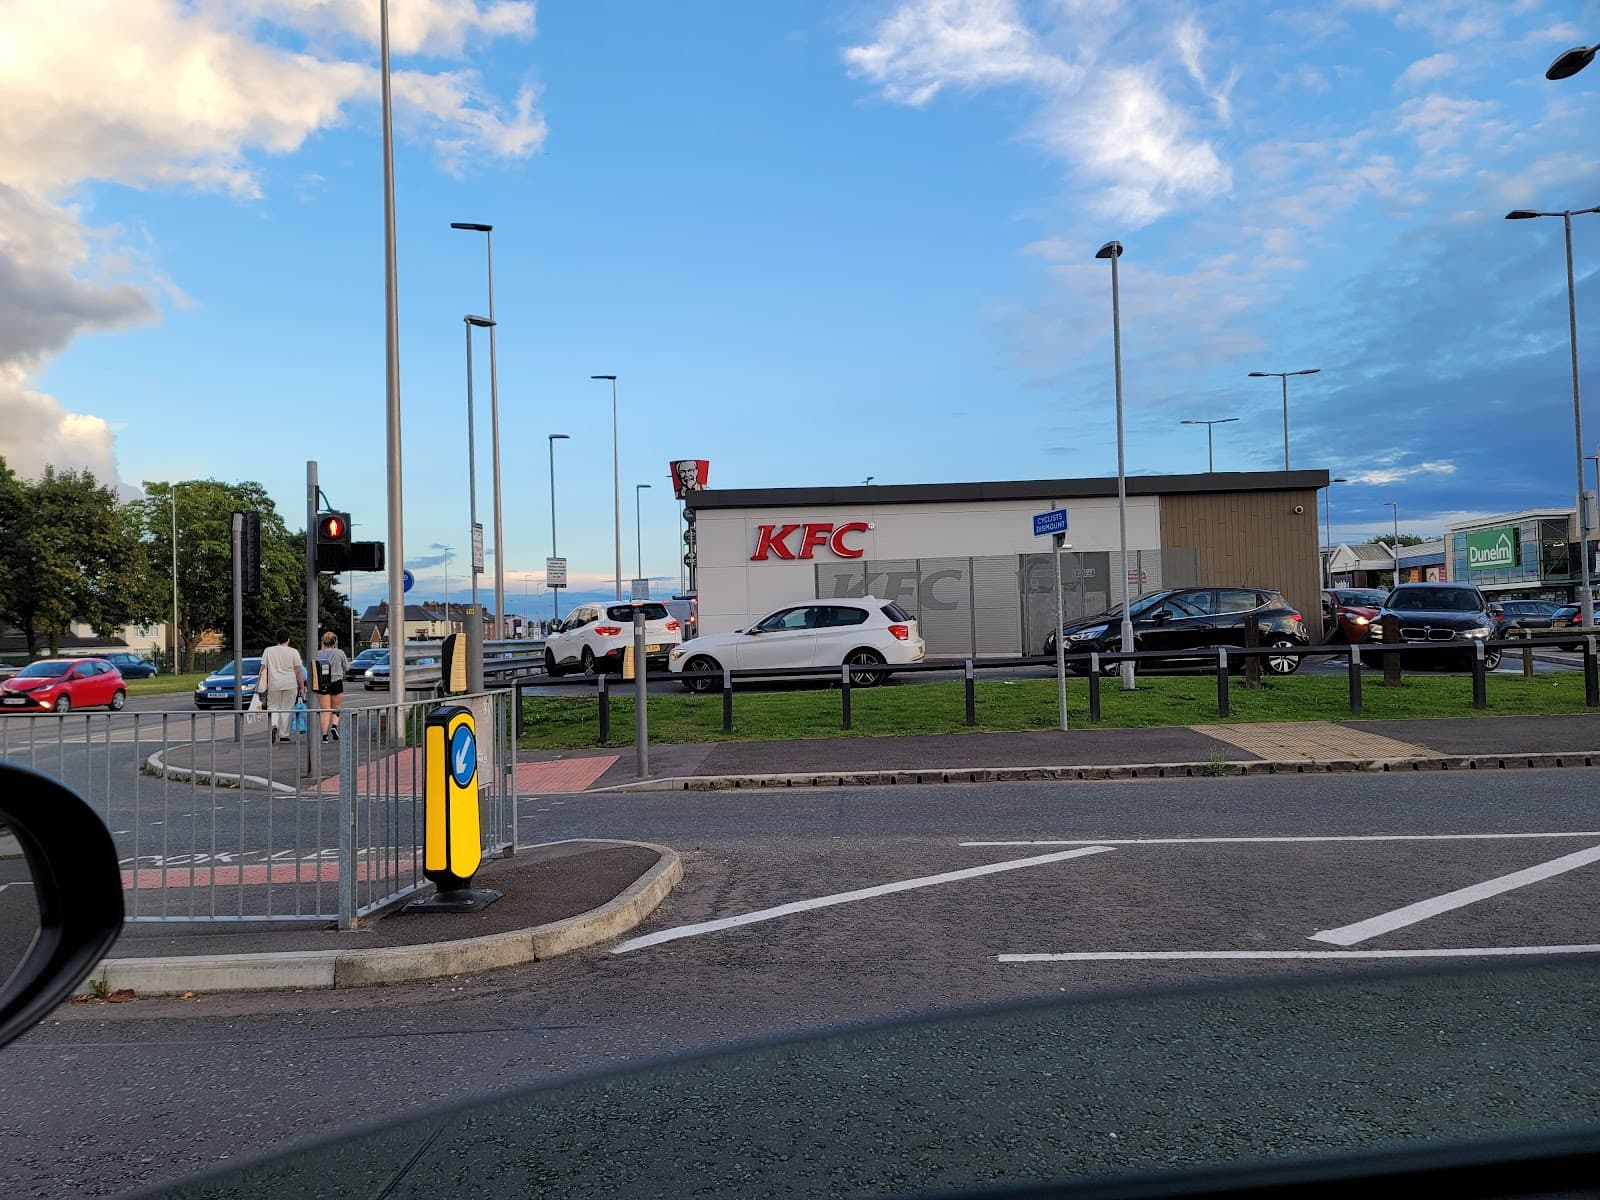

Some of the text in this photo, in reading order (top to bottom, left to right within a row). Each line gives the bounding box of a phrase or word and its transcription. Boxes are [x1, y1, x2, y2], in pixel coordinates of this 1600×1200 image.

[1037, 513, 1063, 524] CYCLISTS
[1036, 521, 1065, 532] DISMOUNT
[751, 522, 868, 560] KFC
[1470, 543, 1509, 562] Dunelm
